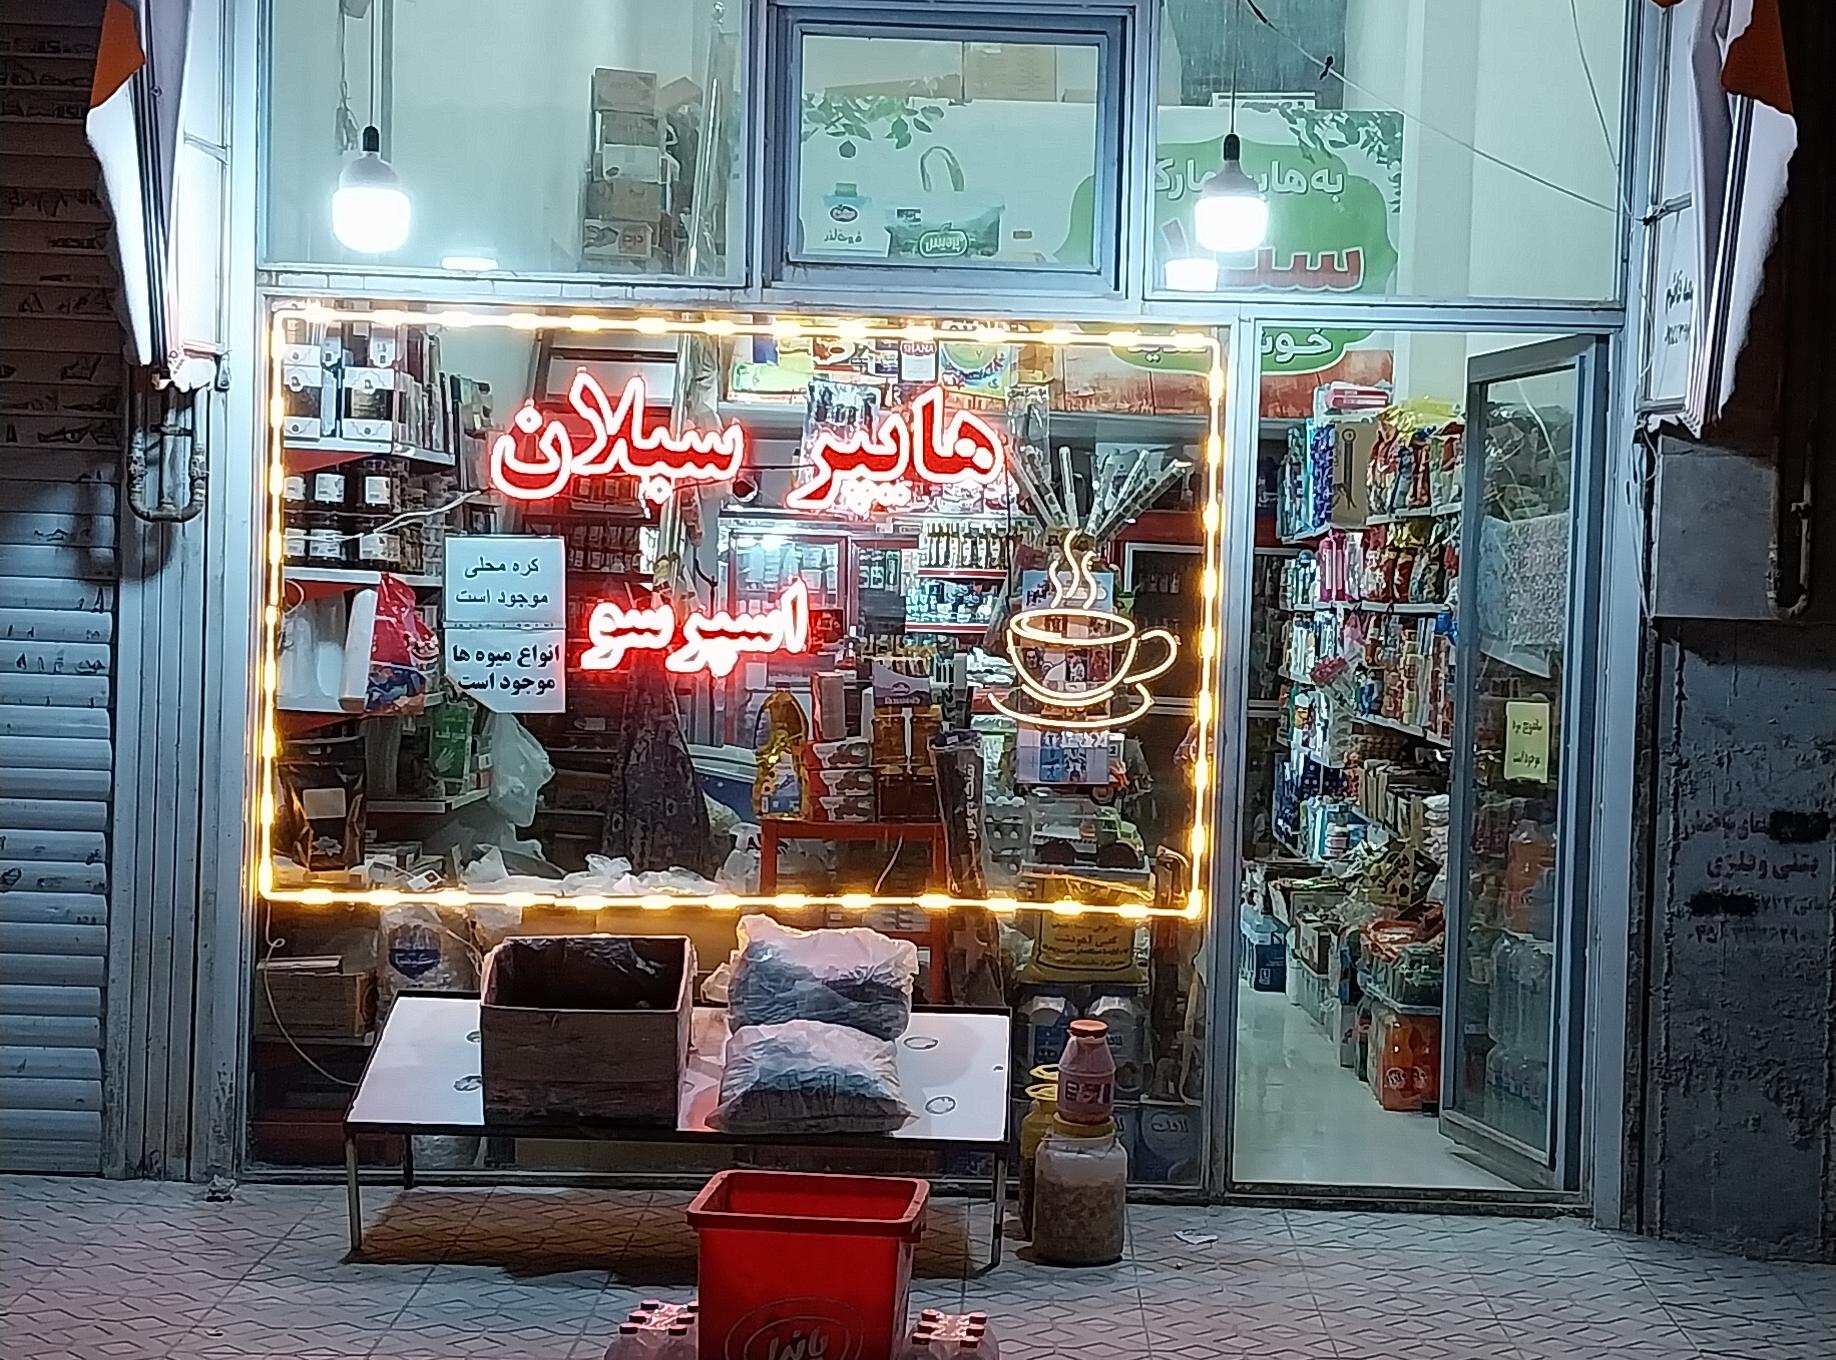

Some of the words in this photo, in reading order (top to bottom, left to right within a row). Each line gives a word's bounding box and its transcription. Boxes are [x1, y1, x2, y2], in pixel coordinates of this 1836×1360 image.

[490, 366, 745, 505] سبلان
[786, 386, 1006, 516] هایپر
[464, 556, 507, 579] محلی
[512, 558, 540, 577] کره
[455, 589, 491, 604] است
[497, 591, 549, 609] موجود
[581, 576, 810, 680] اسپرسو
[452, 644, 471, 662] ها
[475, 649, 512, 668] میوه
[516, 644, 560, 668] انواع
[457, 672, 495, 690] است
[499, 675, 556, 696] موجود
